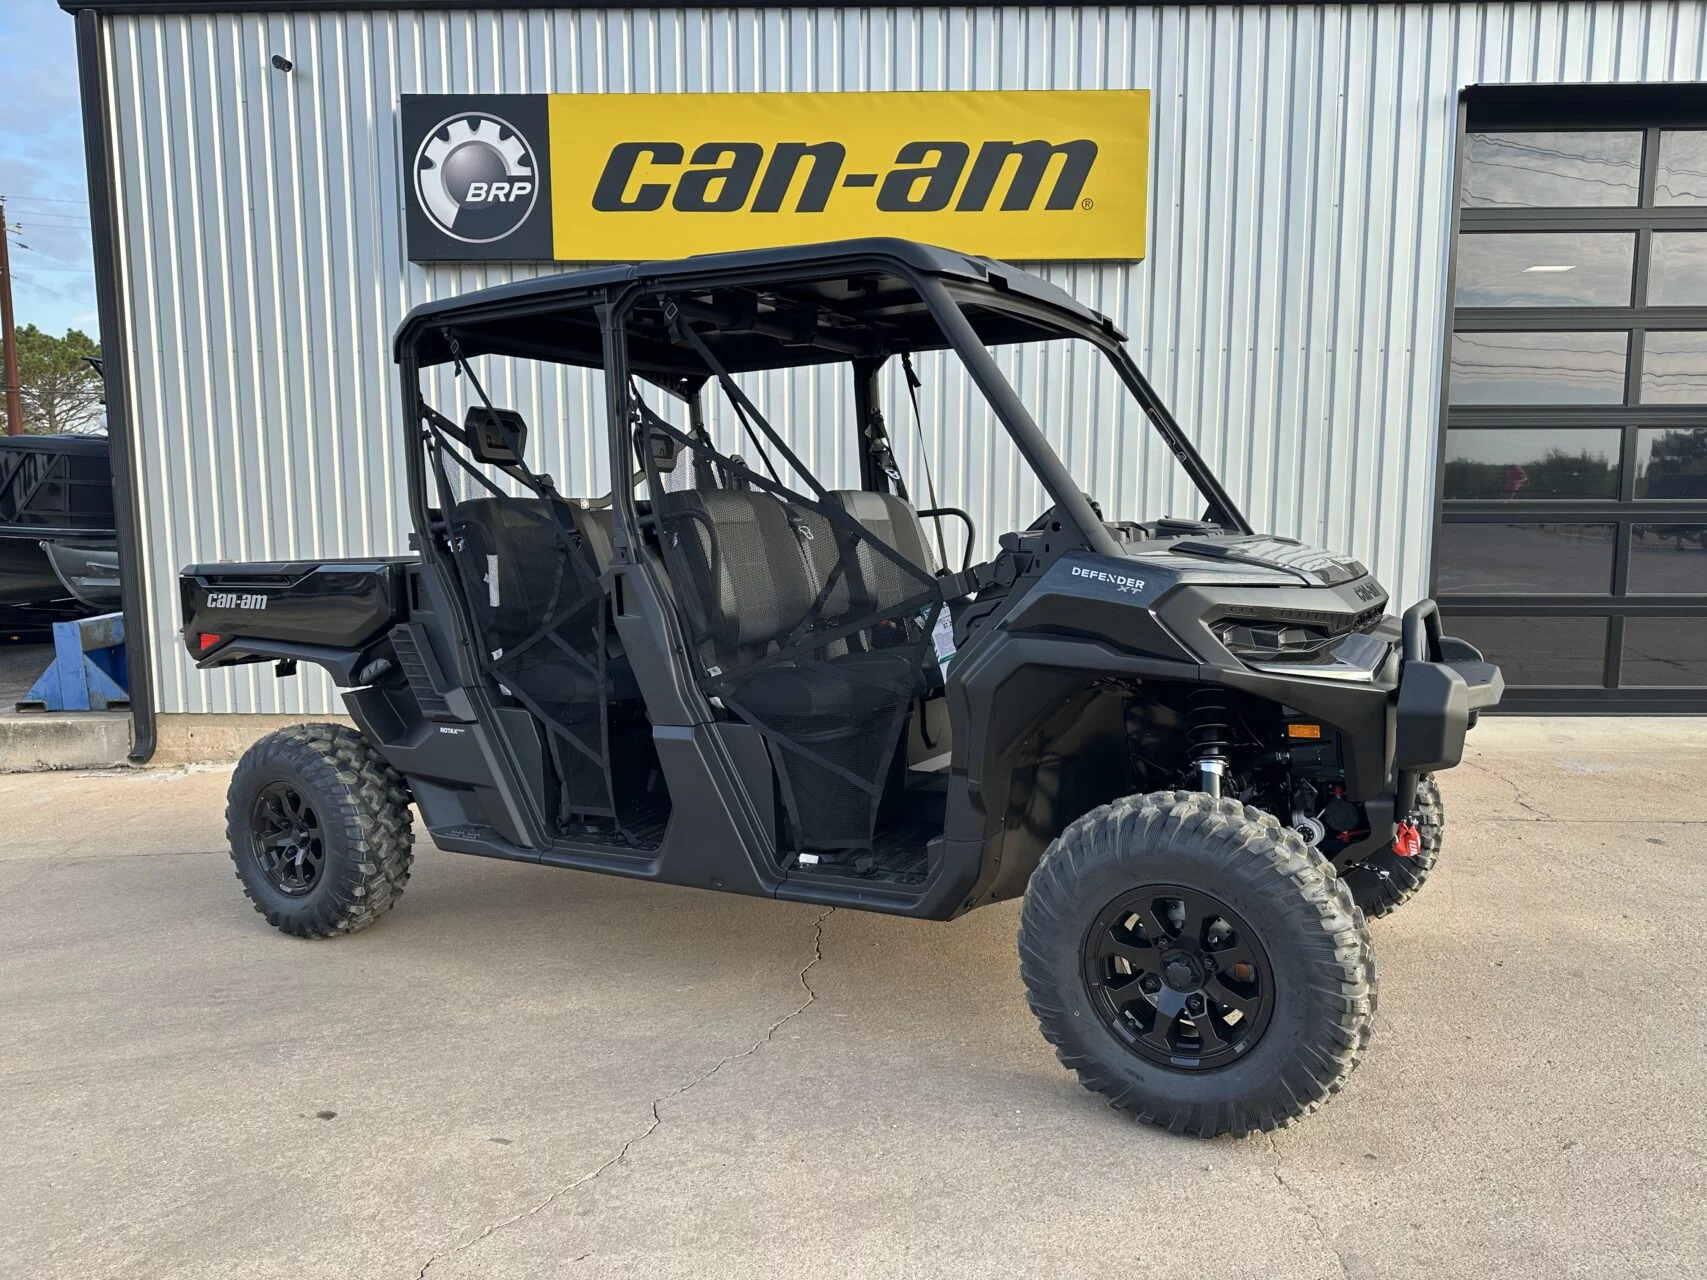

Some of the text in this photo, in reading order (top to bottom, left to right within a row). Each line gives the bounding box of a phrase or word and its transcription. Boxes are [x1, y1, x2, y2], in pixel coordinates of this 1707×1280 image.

[591, 139, 1098, 213] can-am
[465, 182, 532, 202] BRP
[1071, 566, 1145, 589] DEFENDER
[1116, 585, 1142, 595] XT
[206, 593, 268, 610] can-am
